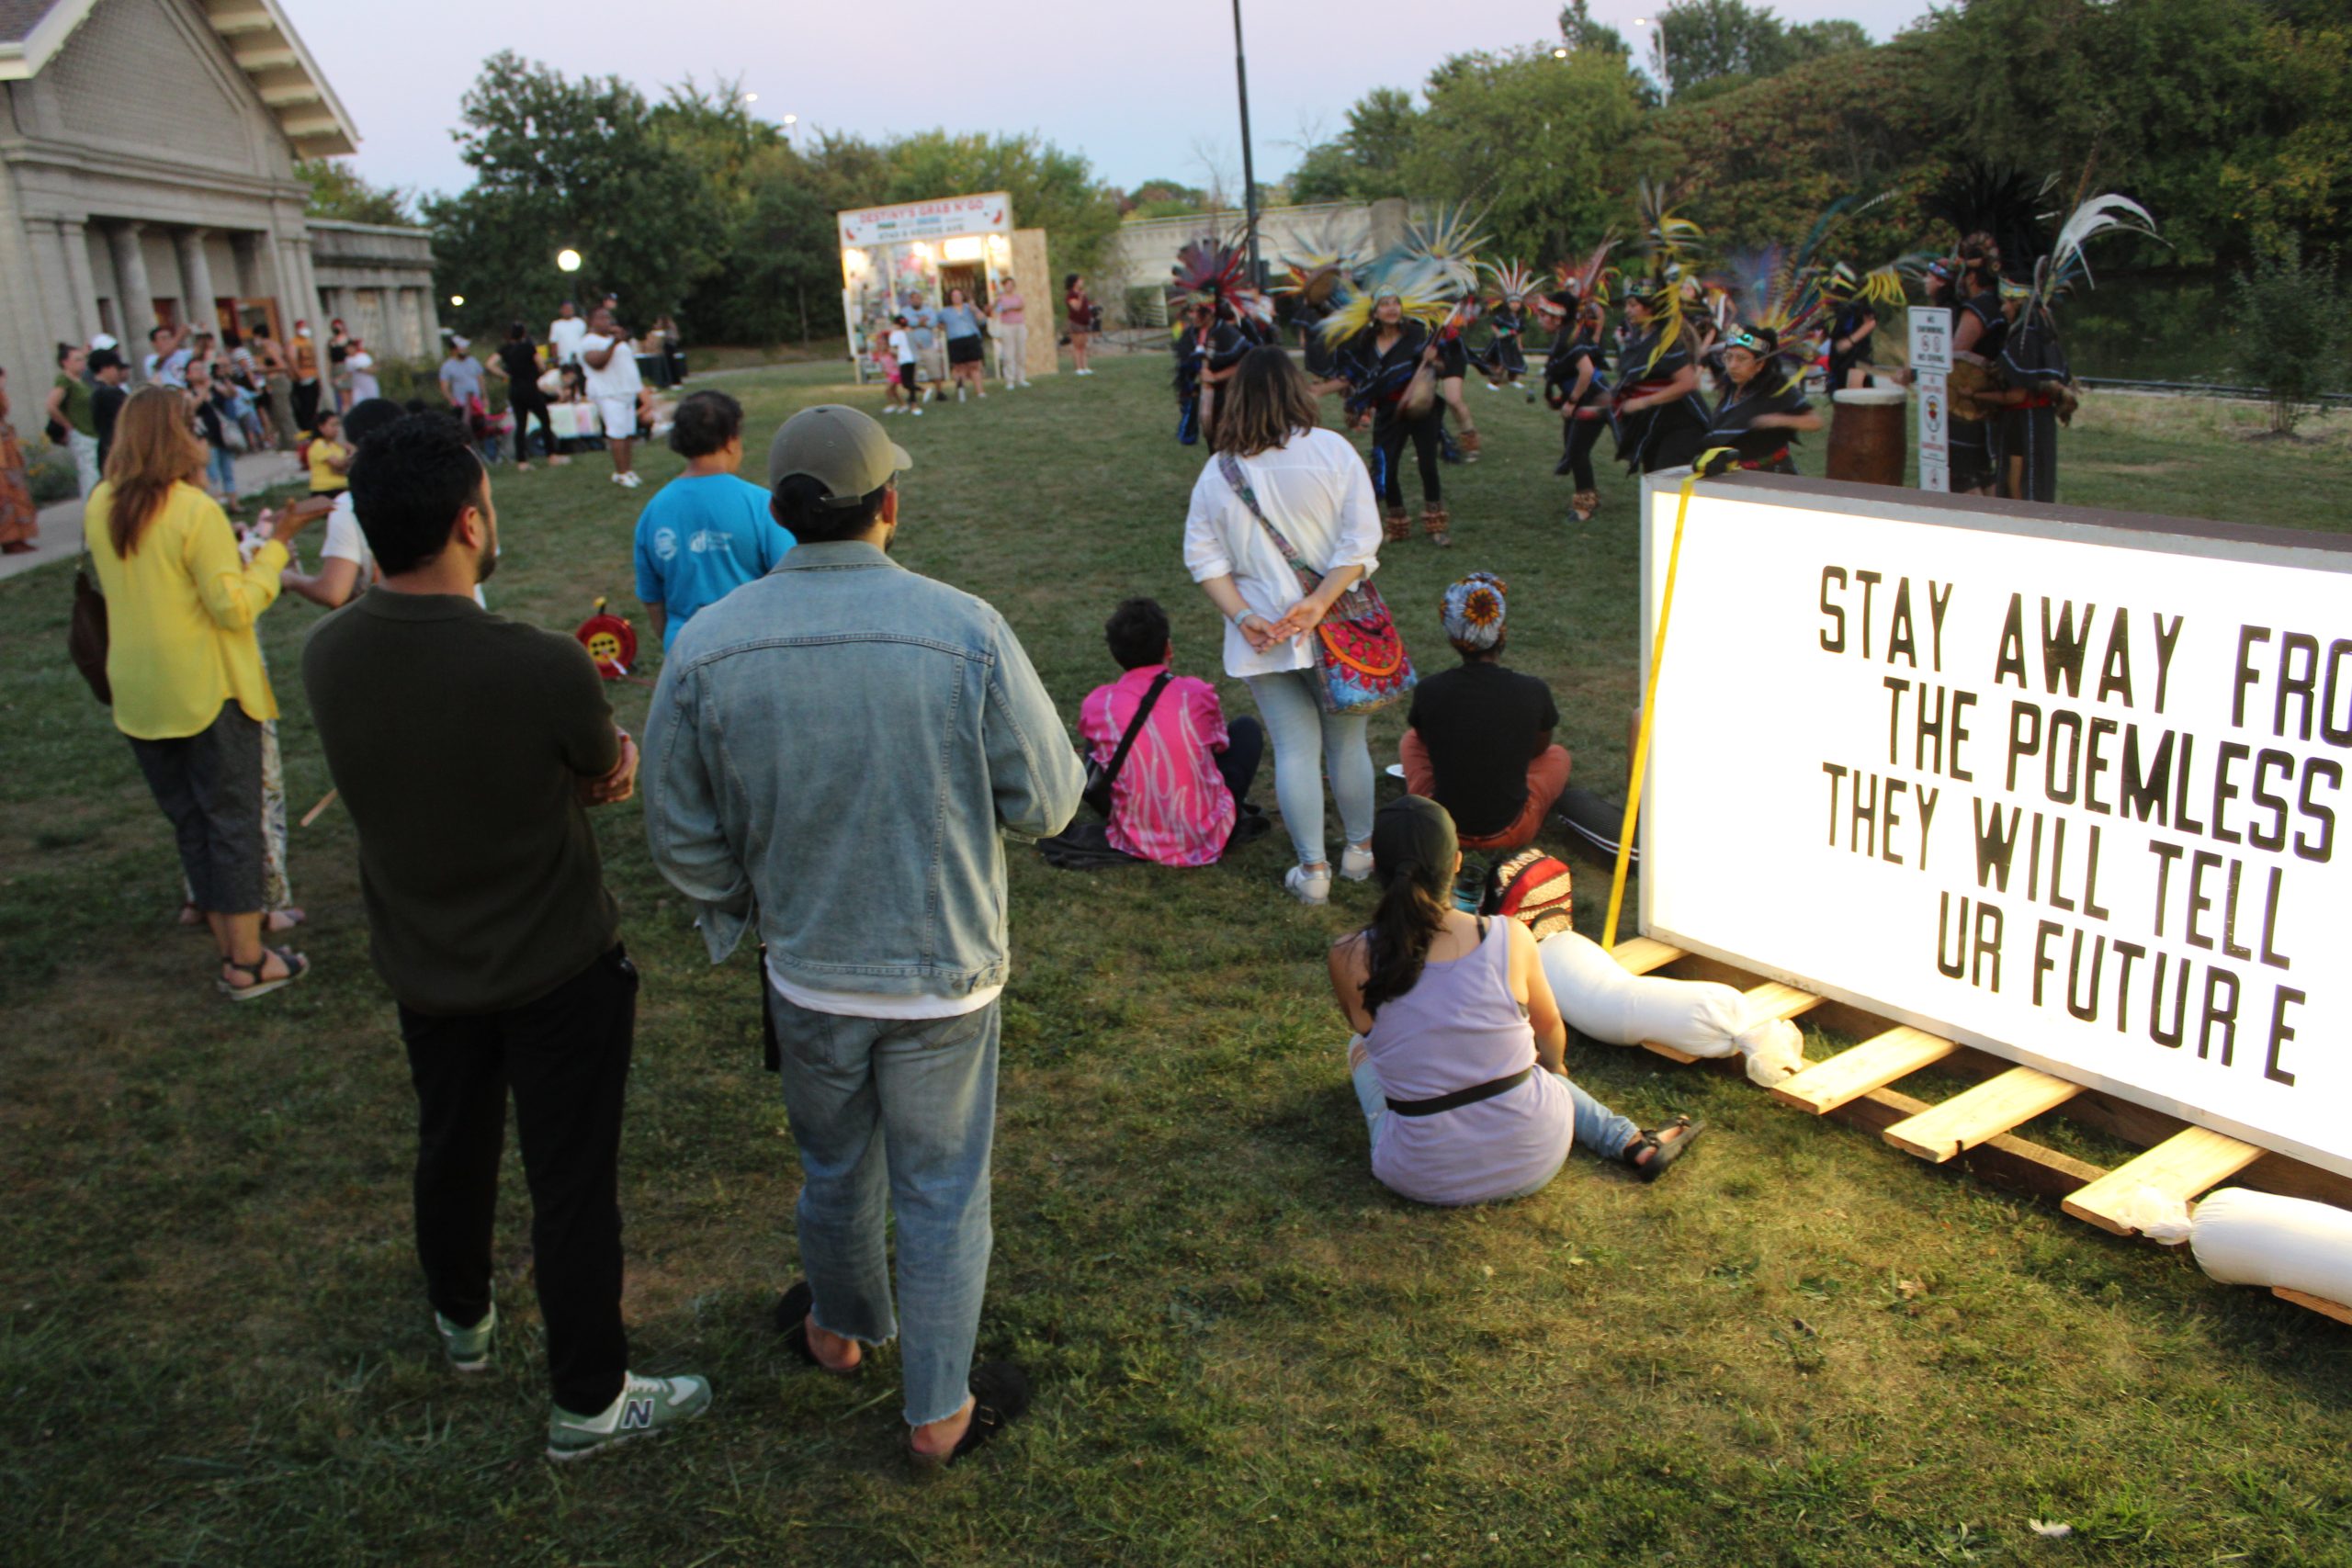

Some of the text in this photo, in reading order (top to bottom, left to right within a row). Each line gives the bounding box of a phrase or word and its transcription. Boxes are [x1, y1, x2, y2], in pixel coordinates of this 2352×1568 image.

[1821, 566, 1951, 671] STAY
[1995, 593, 2183, 714] AWAY
[1884, 677, 2342, 863] THE POEMLESS
[1824, 762, 2290, 969] THEY WILL TELL
[1938, 892, 2305, 1086] UR FUTURE
[620, 1397, 654, 1429] N
